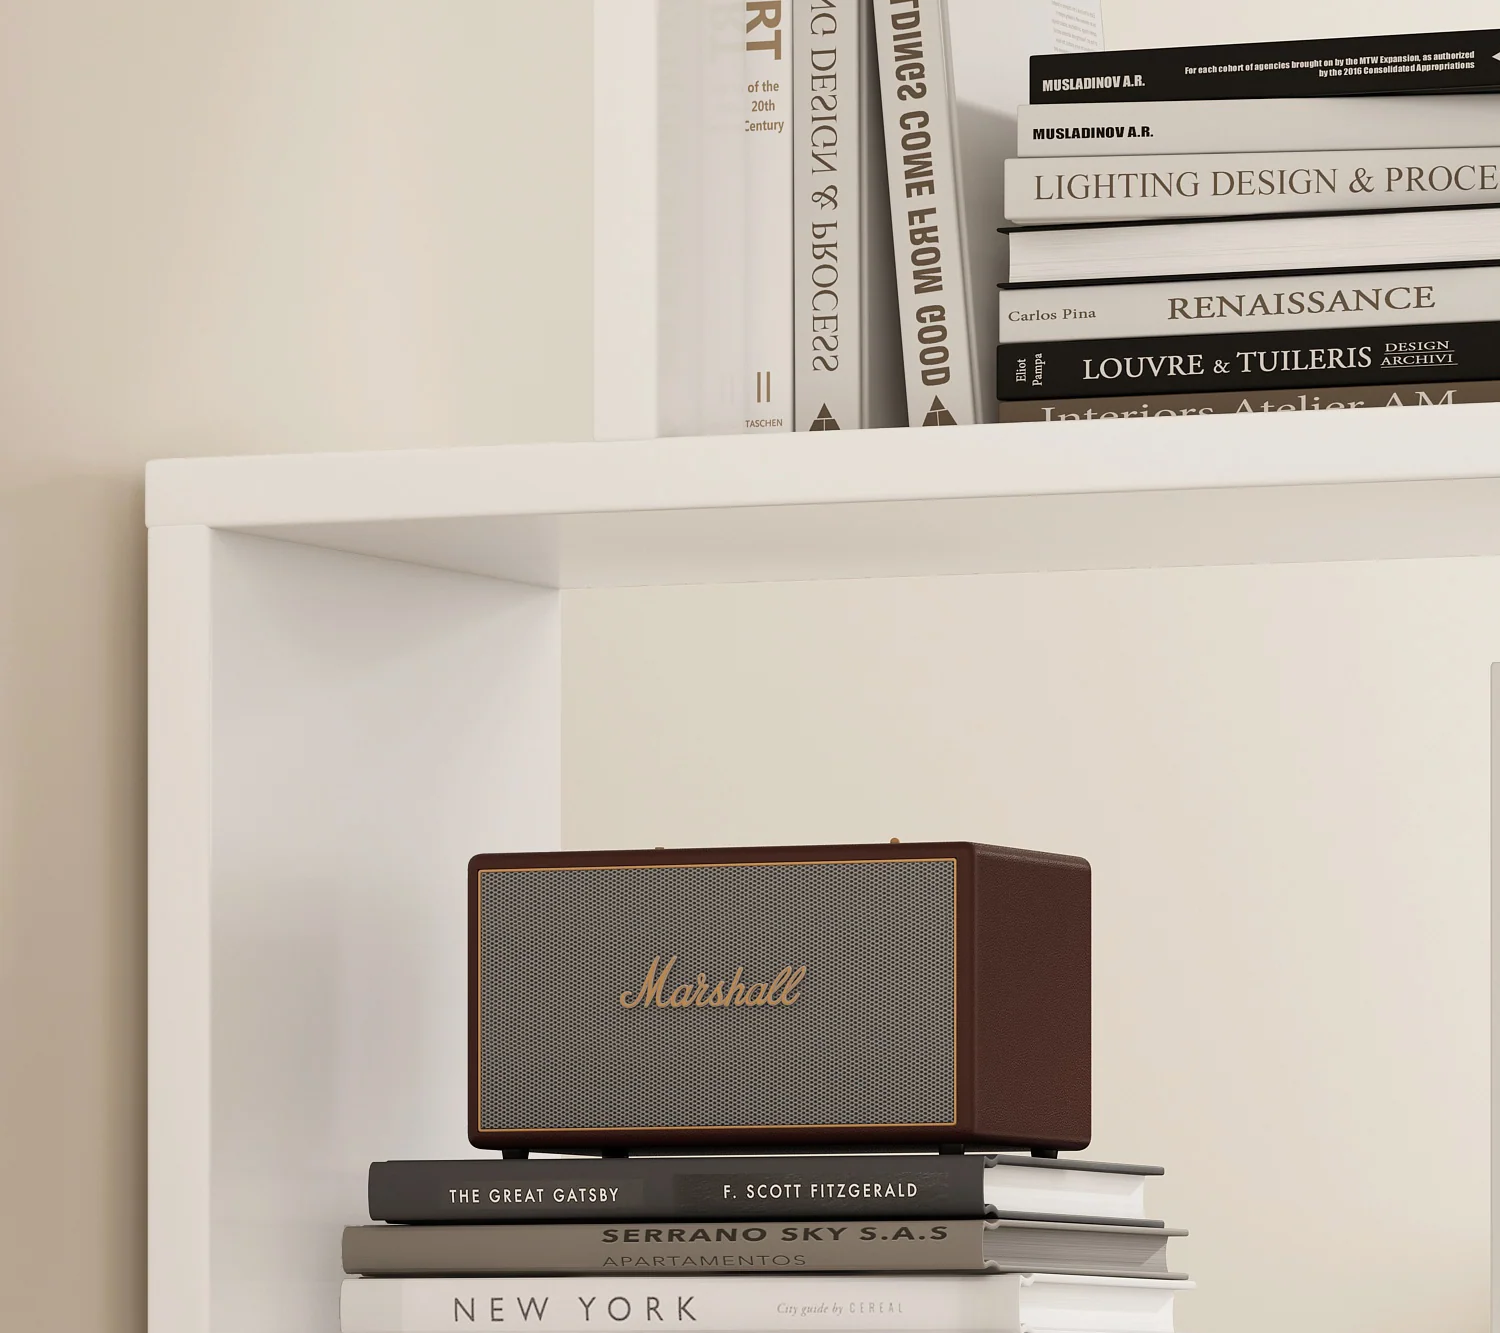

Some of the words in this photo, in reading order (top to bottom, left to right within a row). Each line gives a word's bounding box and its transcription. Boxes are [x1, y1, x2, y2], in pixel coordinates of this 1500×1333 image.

[1219, 64, 1244, 72] cohort
[1245, 63, 1253, 71] of
[1255, 62, 1290, 71] agencies
[1292, 60, 1322, 68] brought
[1360, 56, 1378, 64] MTW
[1434, 51, 1474, 60] authorized
[1043, 76, 1120, 91] MUSLADINOV
[1123, 75, 1145, 87] A.R.
[1033, 127, 1124, 139] MUSLADINOV
[1128, 126, 1153, 137] A.R.
[1035, 172, 1199, 199] LIGHTING
[1212, 169, 1337, 196] DESIGN
[1349, 168, 1374, 193] &
[1168, 286, 1435, 319] RENAISSANCE
[1009, 310, 1056, 321] Carlos
[1063, 309, 1096, 319] Pina
[1385, 341, 1449, 352] DESIGN
[1083, 355, 1204, 379] LOUVRE
[1214, 360, 1230, 373] &
[1236, 347, 1371, 372] TUILERIS
[1380, 354, 1452, 365] ARCHIVI
[745, 419, 782, 428] TASCHEN
[619, 955, 807, 1009] Marshall
[450, 1190, 479, 1203] THE
[489, 1189, 543, 1202] GREAT
[554, 1188, 618, 1202] GATSBY
[724, 1185, 736, 1198] F.
[747, 1184, 801, 1198] SCOTT
[811, 1183, 917, 1197] FITZGERALD
[602, 1228, 766, 1243] SERRANO
[781, 1228, 847, 1241] SKY
[860, 1226, 947, 1240] S.A.S
[603, 1255, 805, 1266] APARTAMENTOS
[455, 1297, 548, 1322] NEW
[579, 1297, 696, 1321] YORK
[777, 1303, 797, 1316] City
[801, 1303, 828, 1317] guide
[832, 1302, 843, 1316] by
